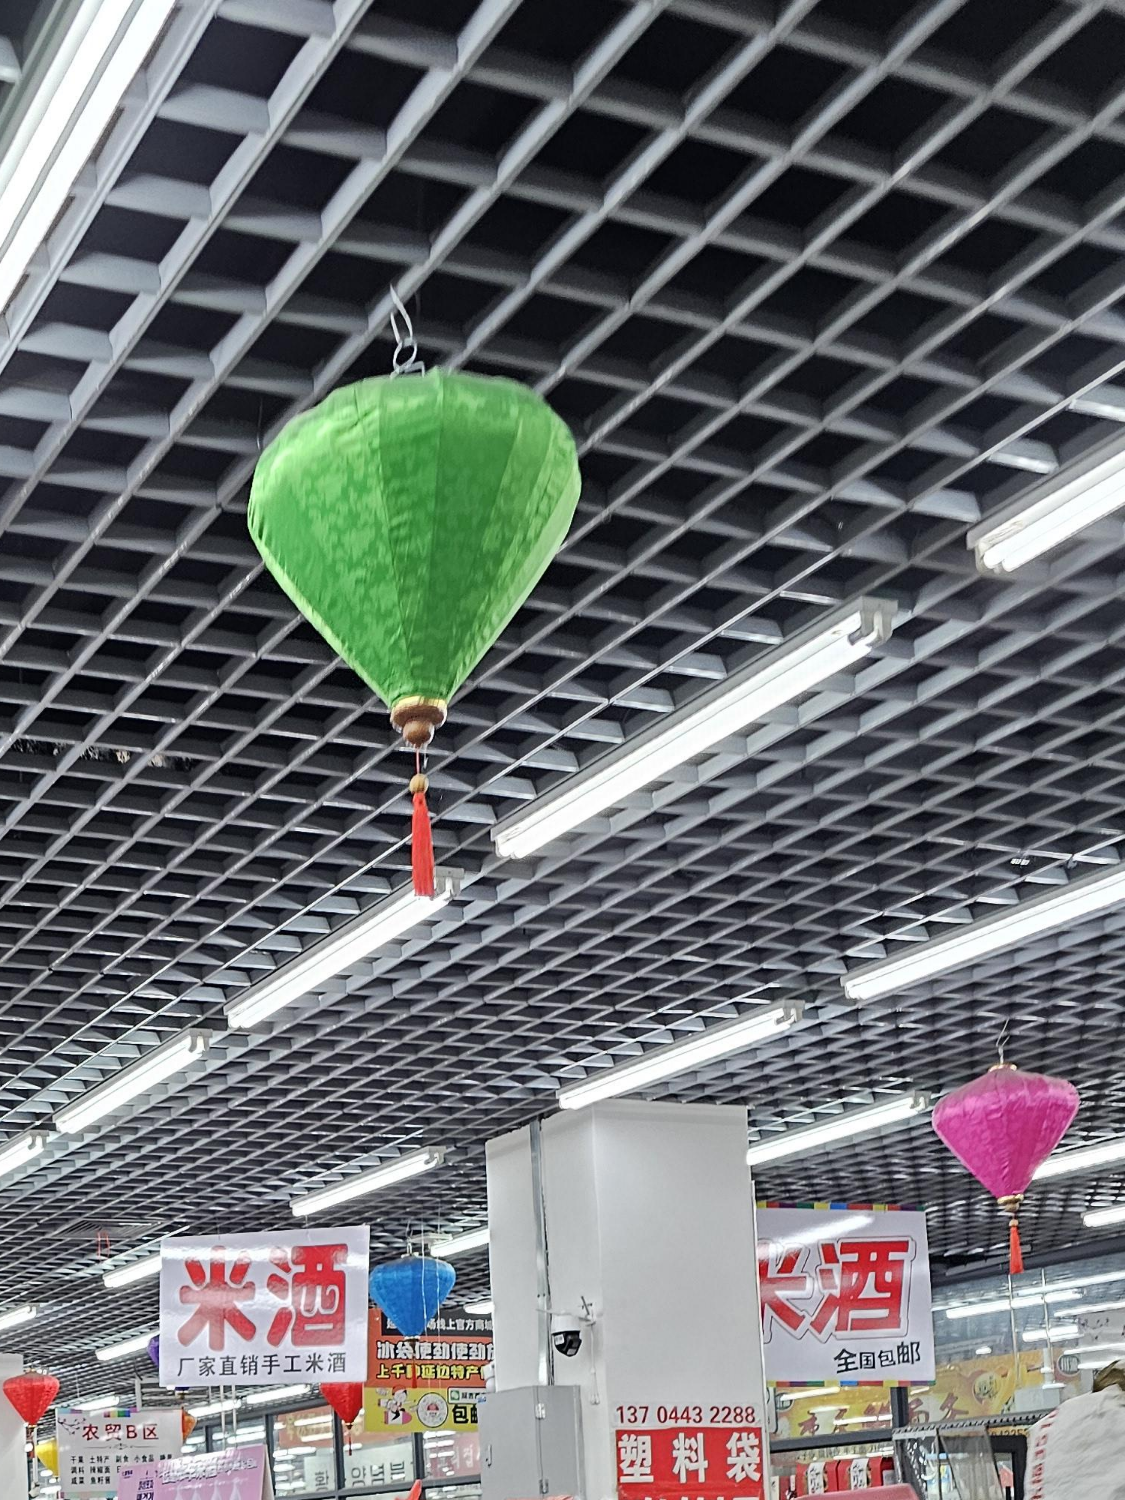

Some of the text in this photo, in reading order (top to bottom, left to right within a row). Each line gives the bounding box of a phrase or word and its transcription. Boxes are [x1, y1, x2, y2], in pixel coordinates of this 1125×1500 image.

[178, 1243, 348, 1351] 米酒
[177, 1352, 346, 1377] 厂家直销手工米酒
[834, 1342, 921, 1374] 全国包邮
[376, 1364, 485, 1380] 上千种延边特产
[616, 1405, 756, 1424] 137 0443 2288
[82, 1424, 159, 1441] 农贸B区
[618, 1432, 762, 1484] 塑料袋
